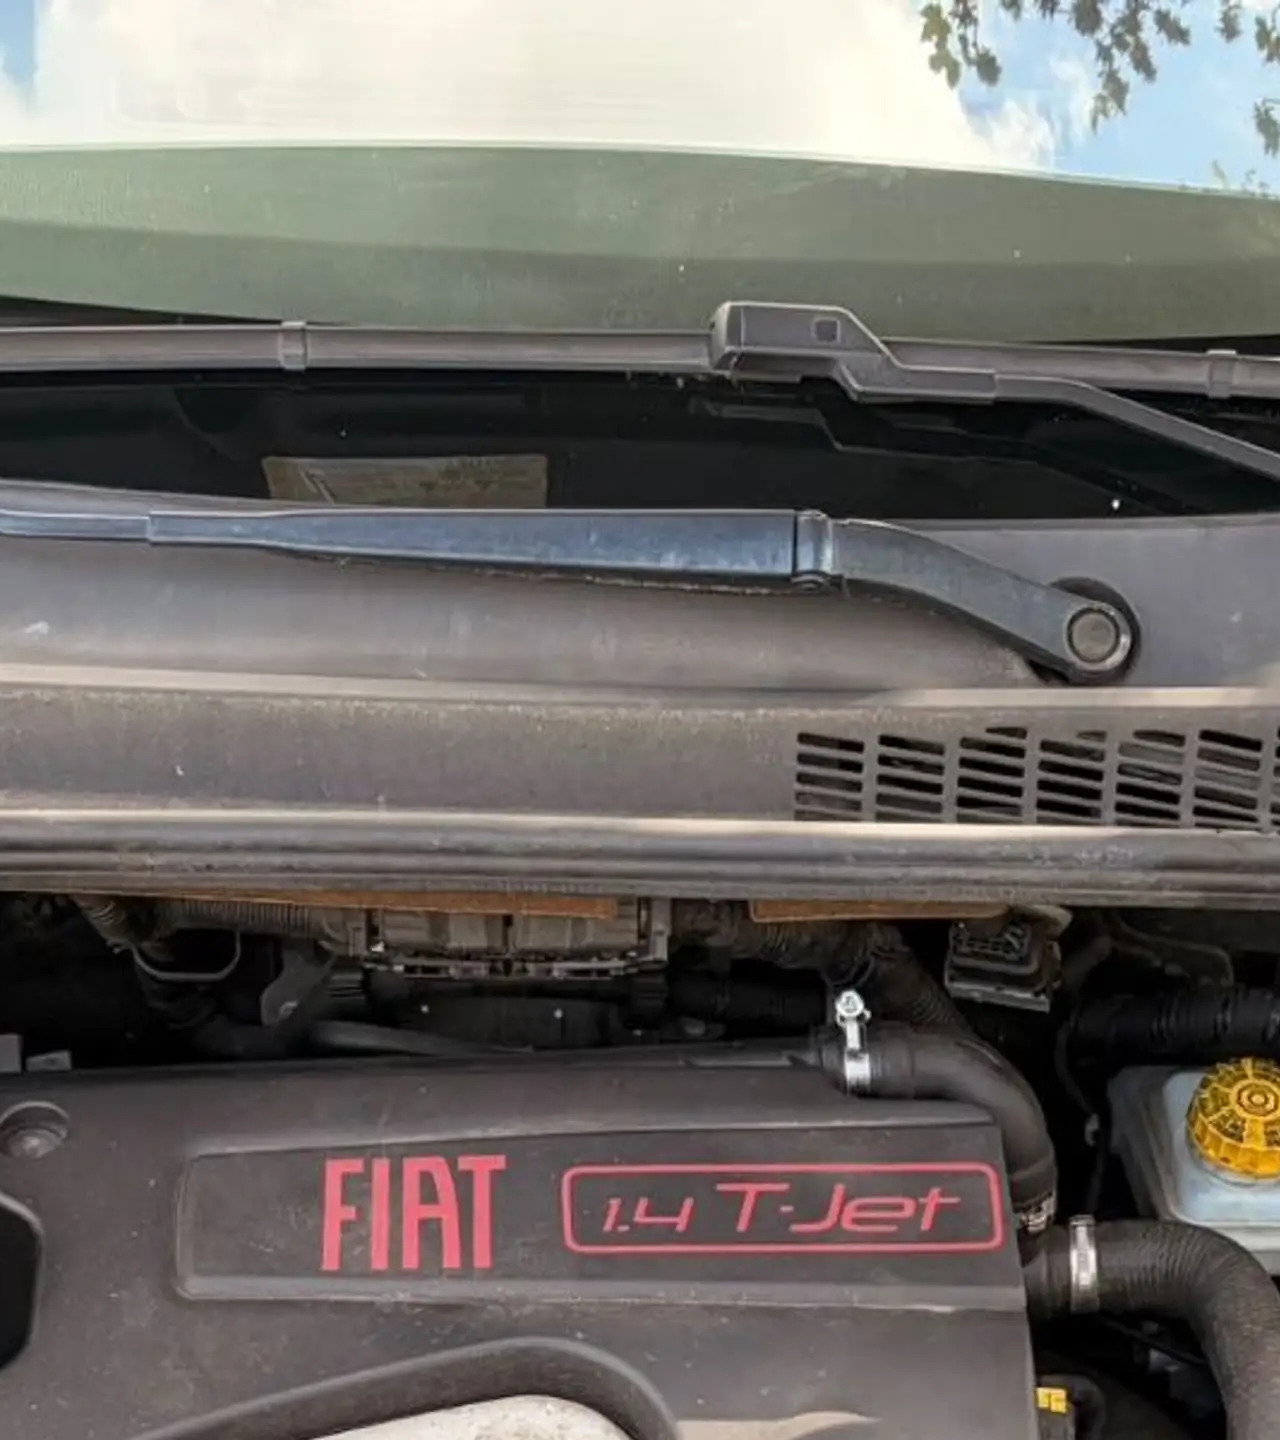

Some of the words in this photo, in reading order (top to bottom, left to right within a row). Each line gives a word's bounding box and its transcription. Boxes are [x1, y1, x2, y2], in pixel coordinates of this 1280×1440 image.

[320, 1154, 506, 1271] FIAT
[602, 1197, 694, 1233] 1.4
[713, 1182, 961, 1233] T-Jet
